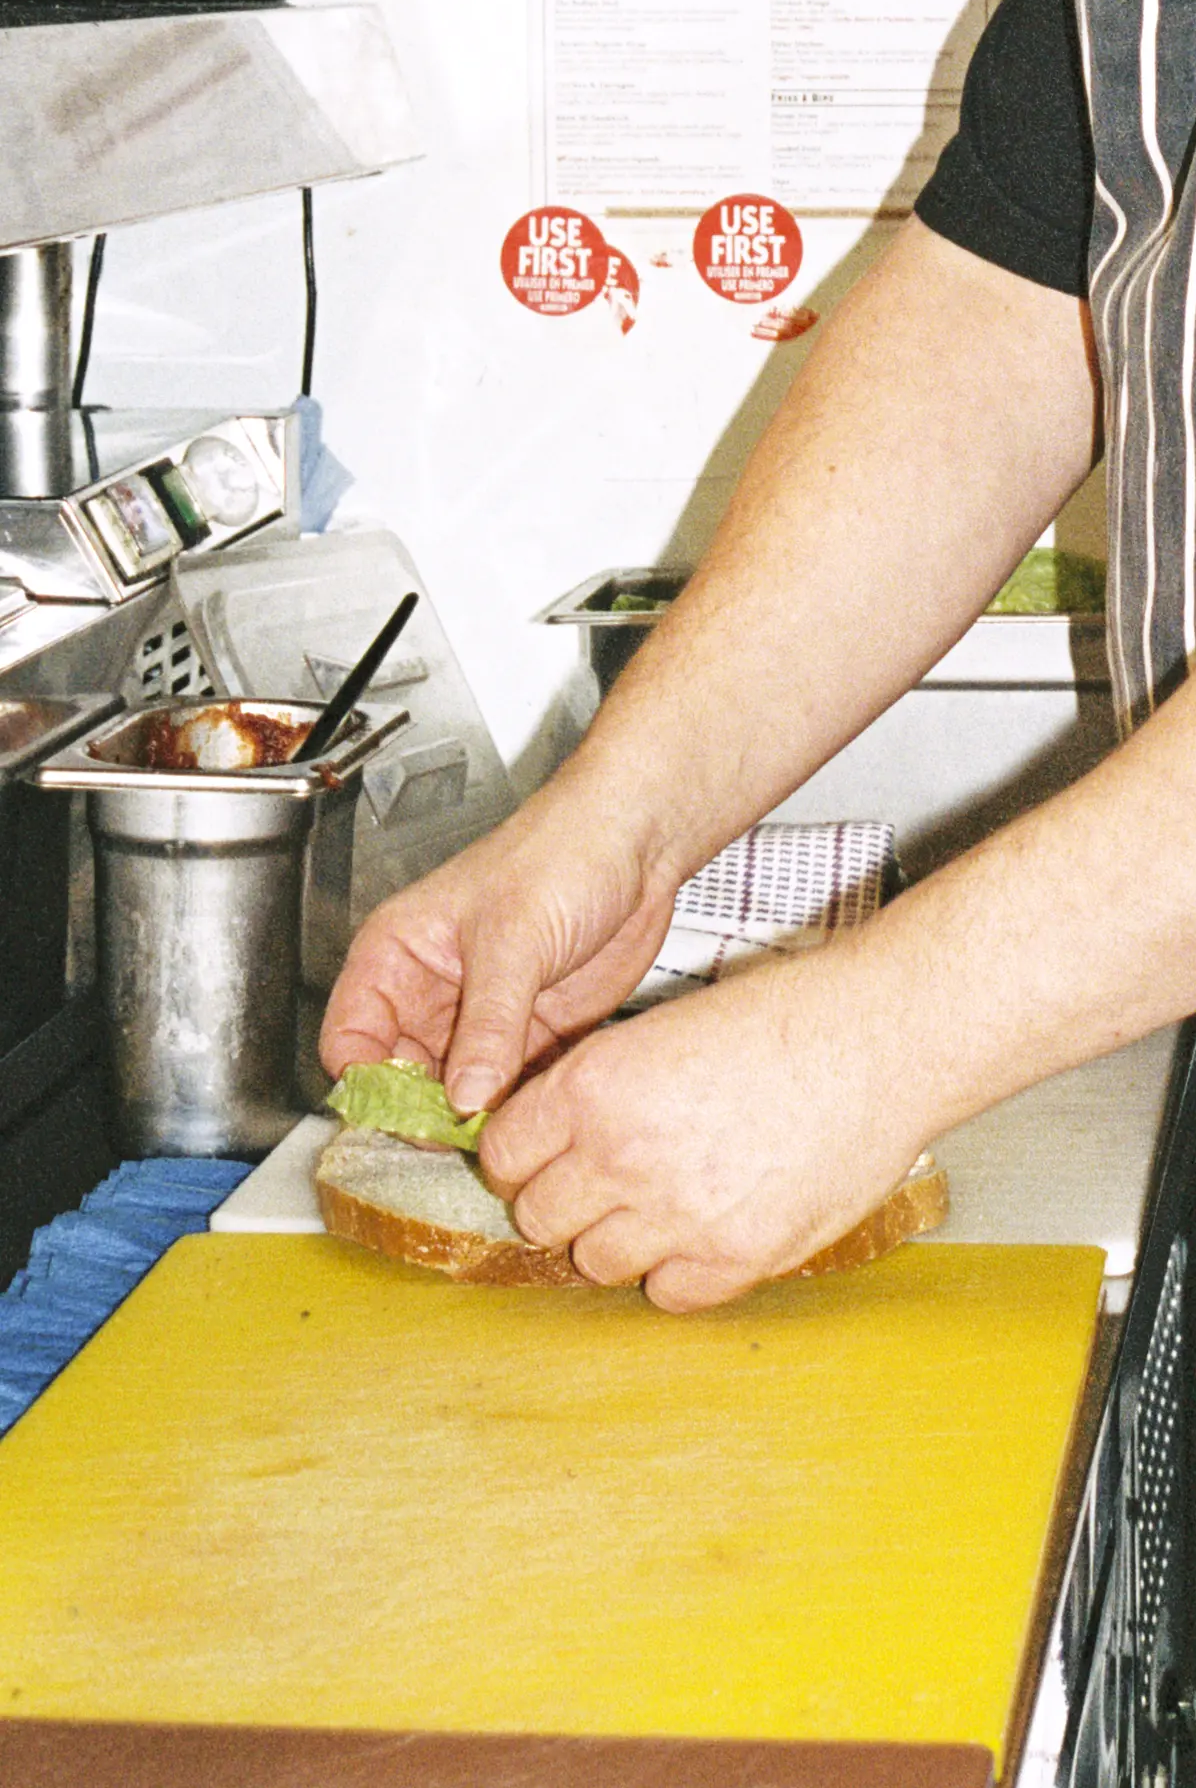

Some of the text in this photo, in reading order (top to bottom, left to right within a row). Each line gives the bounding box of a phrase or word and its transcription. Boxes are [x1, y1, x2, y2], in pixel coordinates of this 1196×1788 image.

[528, 215, 583, 247] USE
[720, 205, 774, 235] USE
[518, 246, 591, 277] FIRST
[711, 235, 786, 265] FIRST
